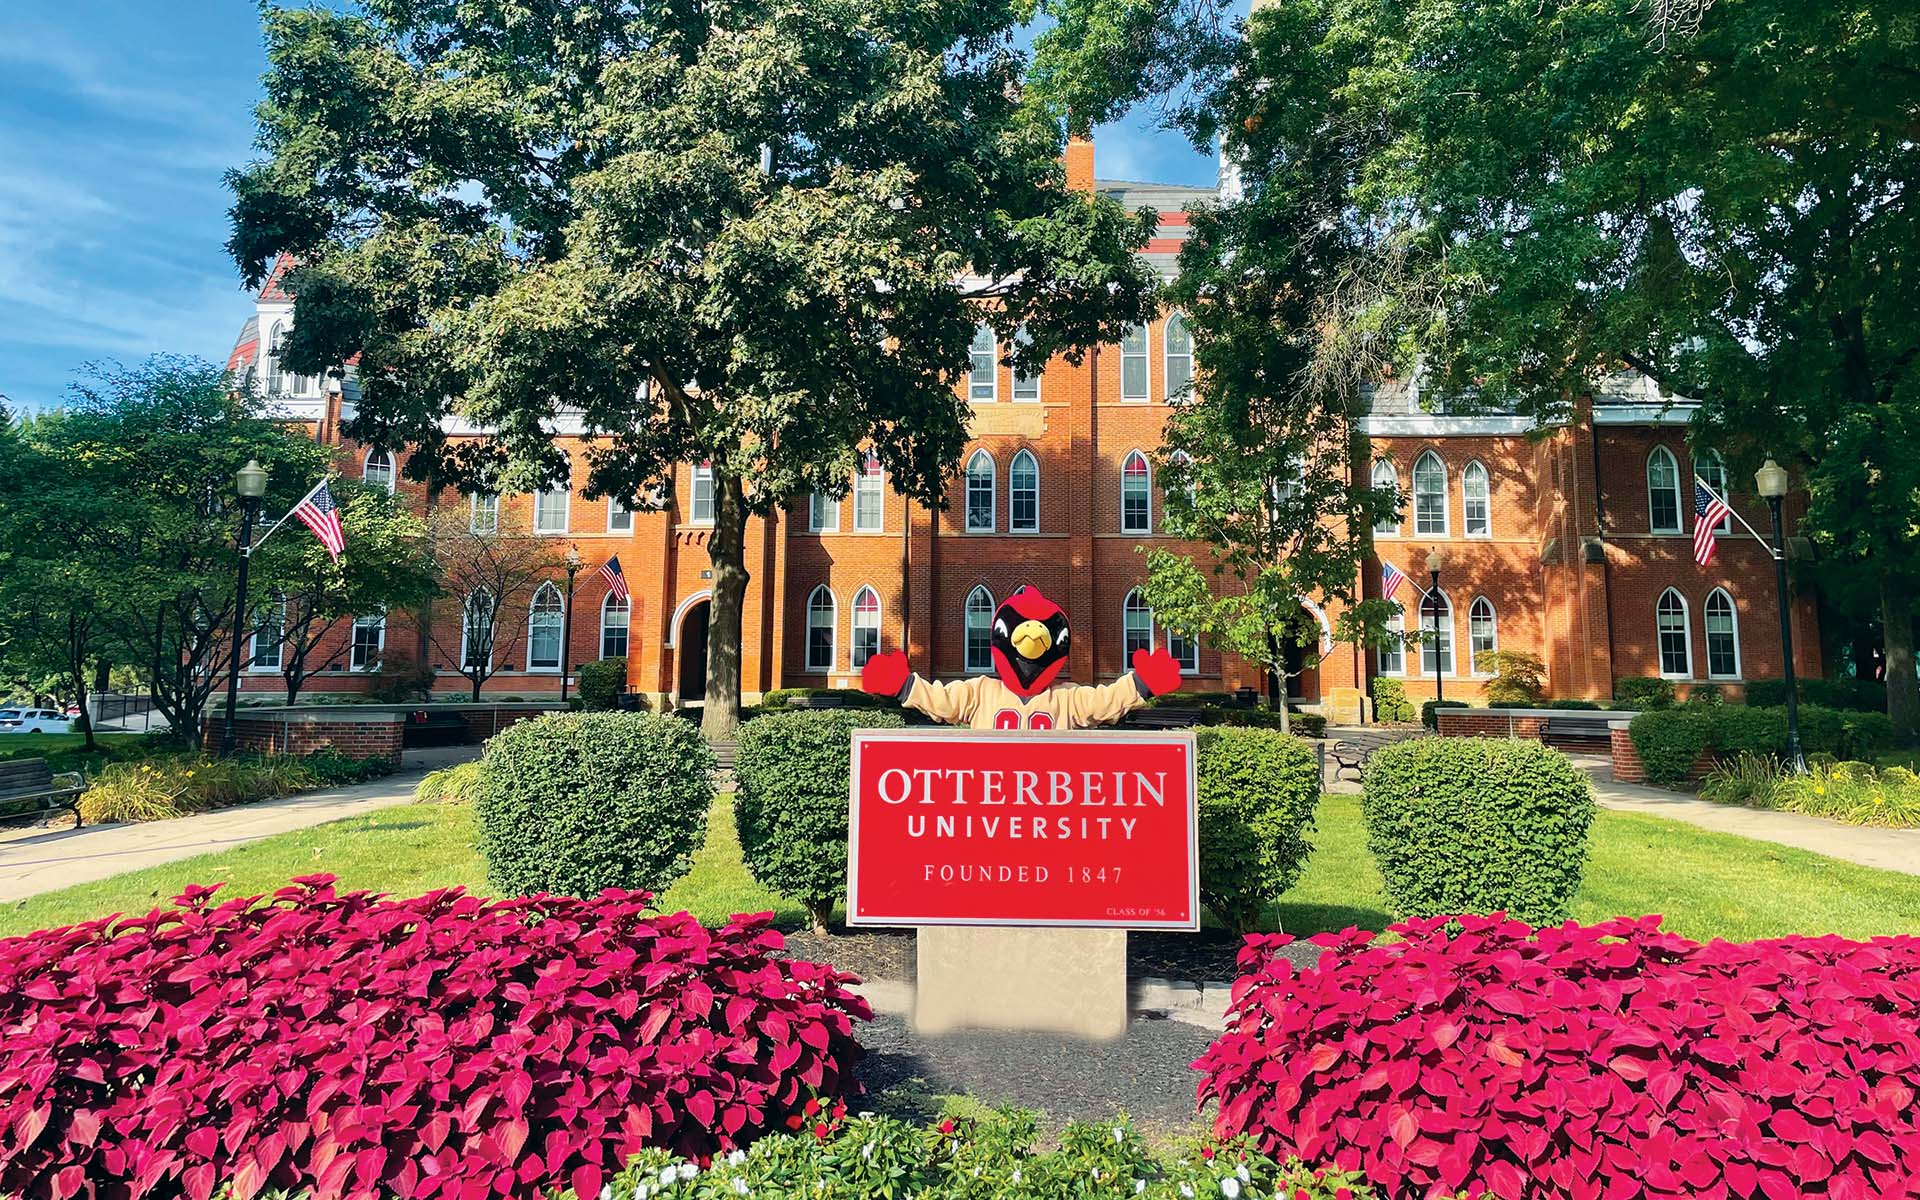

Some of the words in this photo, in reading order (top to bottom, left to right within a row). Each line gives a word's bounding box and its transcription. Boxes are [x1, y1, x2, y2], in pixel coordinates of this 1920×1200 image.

[877, 768, 1167, 807] OTTERBEIN
[908, 815, 1137, 840] UNIVERSITY
[924, 864, 1049, 882] FOUNDED
[1068, 866, 1122, 884] 1847
[1106, 907, 1136, 916] CLASS
[1138, 908, 1150, 916] OF
